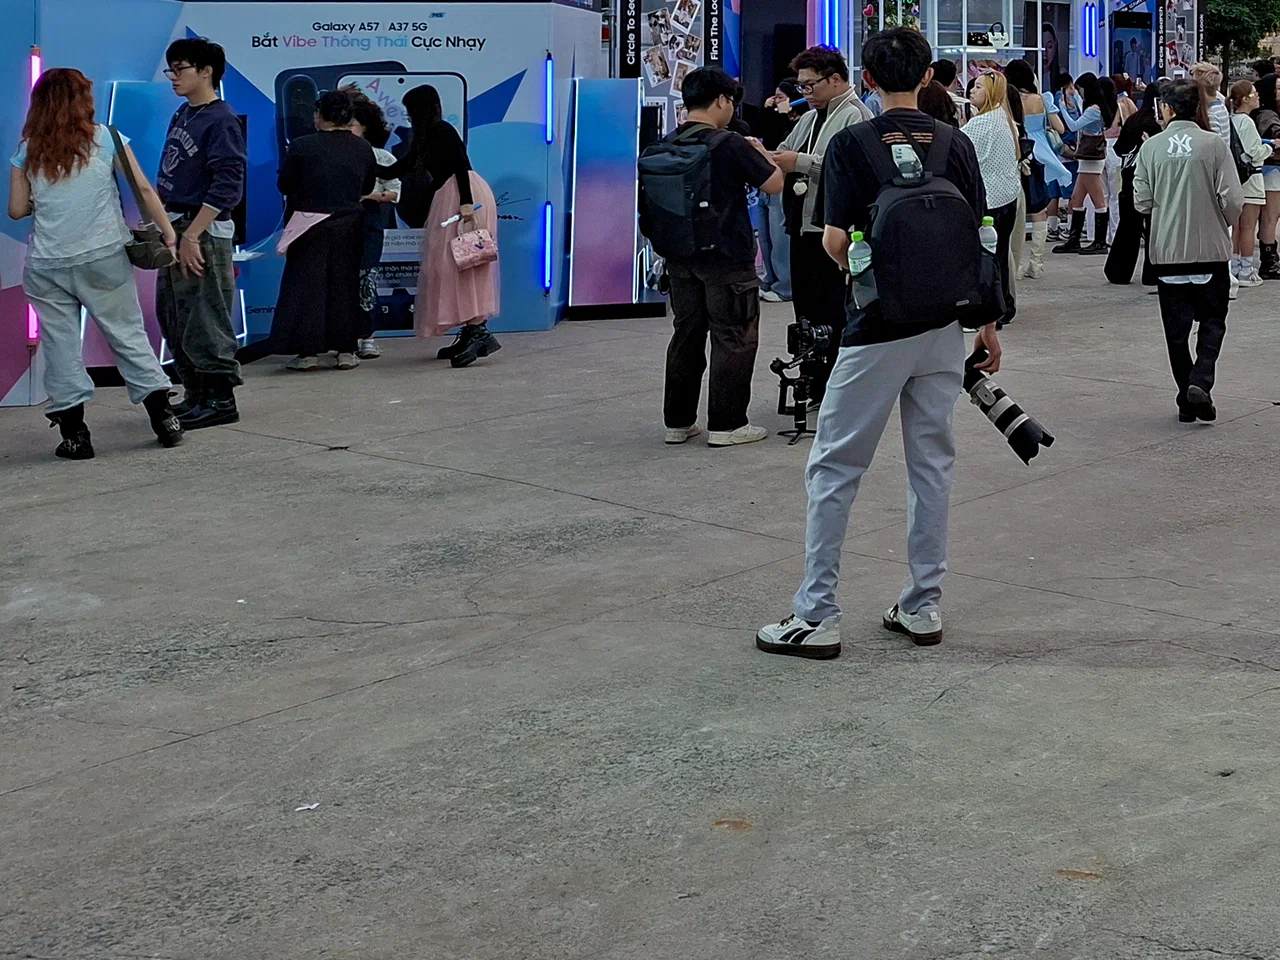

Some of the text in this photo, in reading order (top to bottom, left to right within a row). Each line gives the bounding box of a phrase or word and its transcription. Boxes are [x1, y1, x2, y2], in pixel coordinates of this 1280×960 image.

[312, 22, 428, 34] Galaxy A57 A37 5G
[627, 16, 636, 31] To
[710, 18, 719, 37] The
[251, 32, 486, 51] Bắt Vibe Thông Thái Cực Nhạy
[626, 33, 636, 65] Circle
[710, 38, 719, 60] Find
[1158, 35, 1164, 44] To
